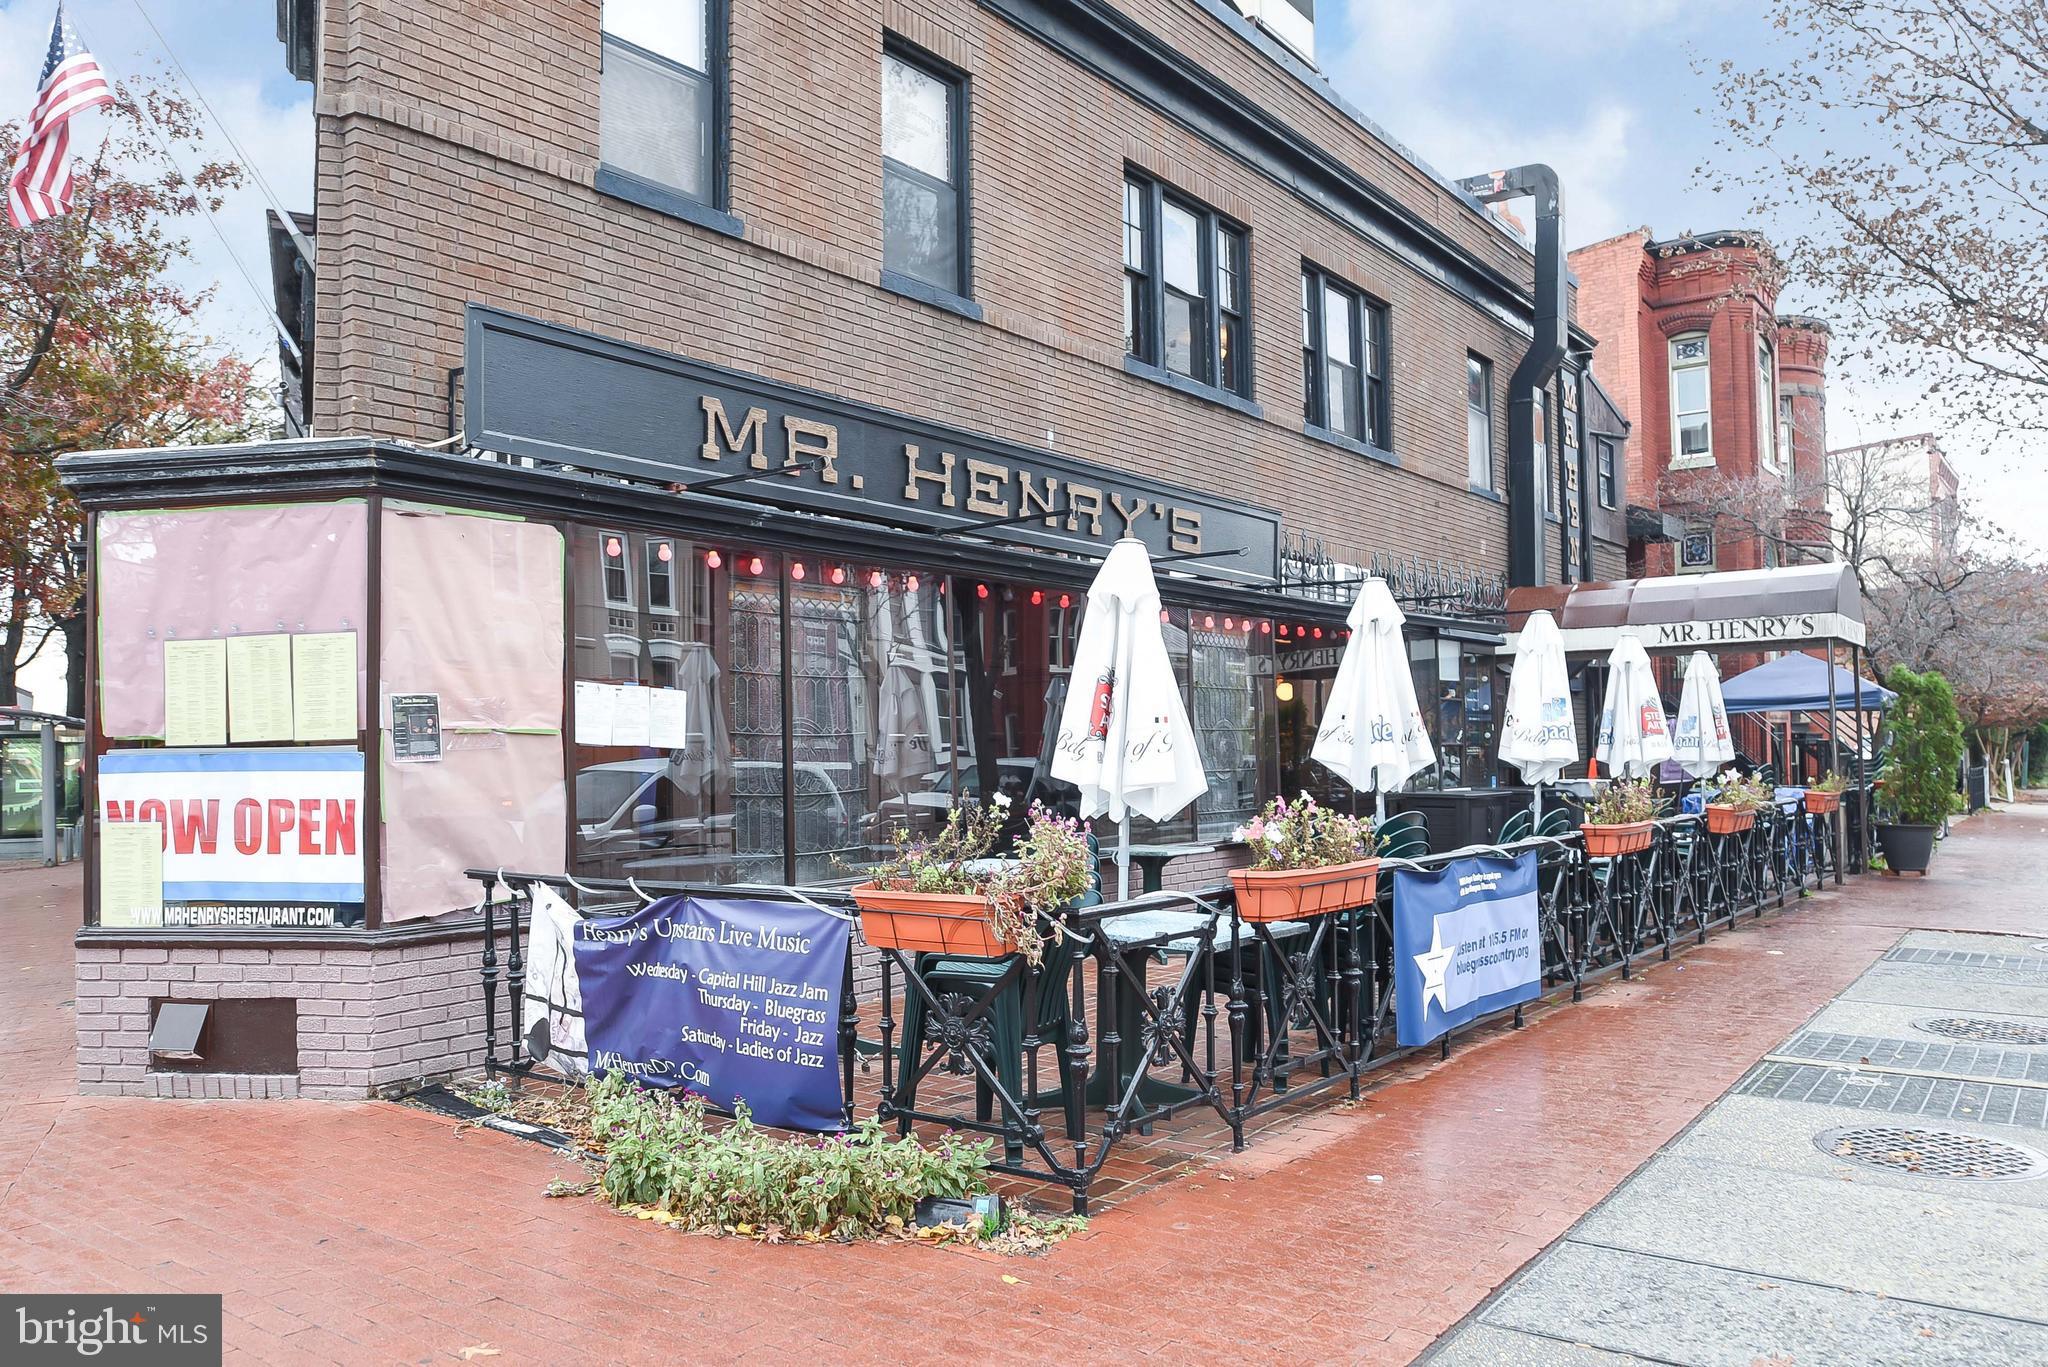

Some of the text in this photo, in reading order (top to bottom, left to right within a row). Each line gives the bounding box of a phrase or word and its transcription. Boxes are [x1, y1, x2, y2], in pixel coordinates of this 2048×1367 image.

[700, 395, 1203, 555] MR. HENRY'S
[1657, 615, 1816, 644] MR. HENRY'S
[234, 797, 357, 856] OPEN
[131, 906, 335, 926] WWW.MRHENRYSRESTAURANT.COM
[653, 916, 715, 945] Upstairs
[719, 920, 752, 949] Live
[757, 925, 811, 955] Music
[1489, 930, 1507, 948] 15.5
[1509, 927, 1521, 942] FM
[698, 967, 741, 990] Capital
[743, 973, 766, 993] Hill
[768, 978, 798, 998] Jazz
[799, 982, 829, 1002] Jam
[697, 987, 751, 1016] Thursday
[764, 998, 827, 1025] Bluegrass
[681, 1025, 726, 1054] Saturday
[735, 1037, 774, 1061] Ladies
[776, 1045, 792, 1063] of
[793, 1048, 825, 1068] Jazz
[740, 1016, 781, 1043] Friday
[794, 1026, 825, 1047] Jazz
